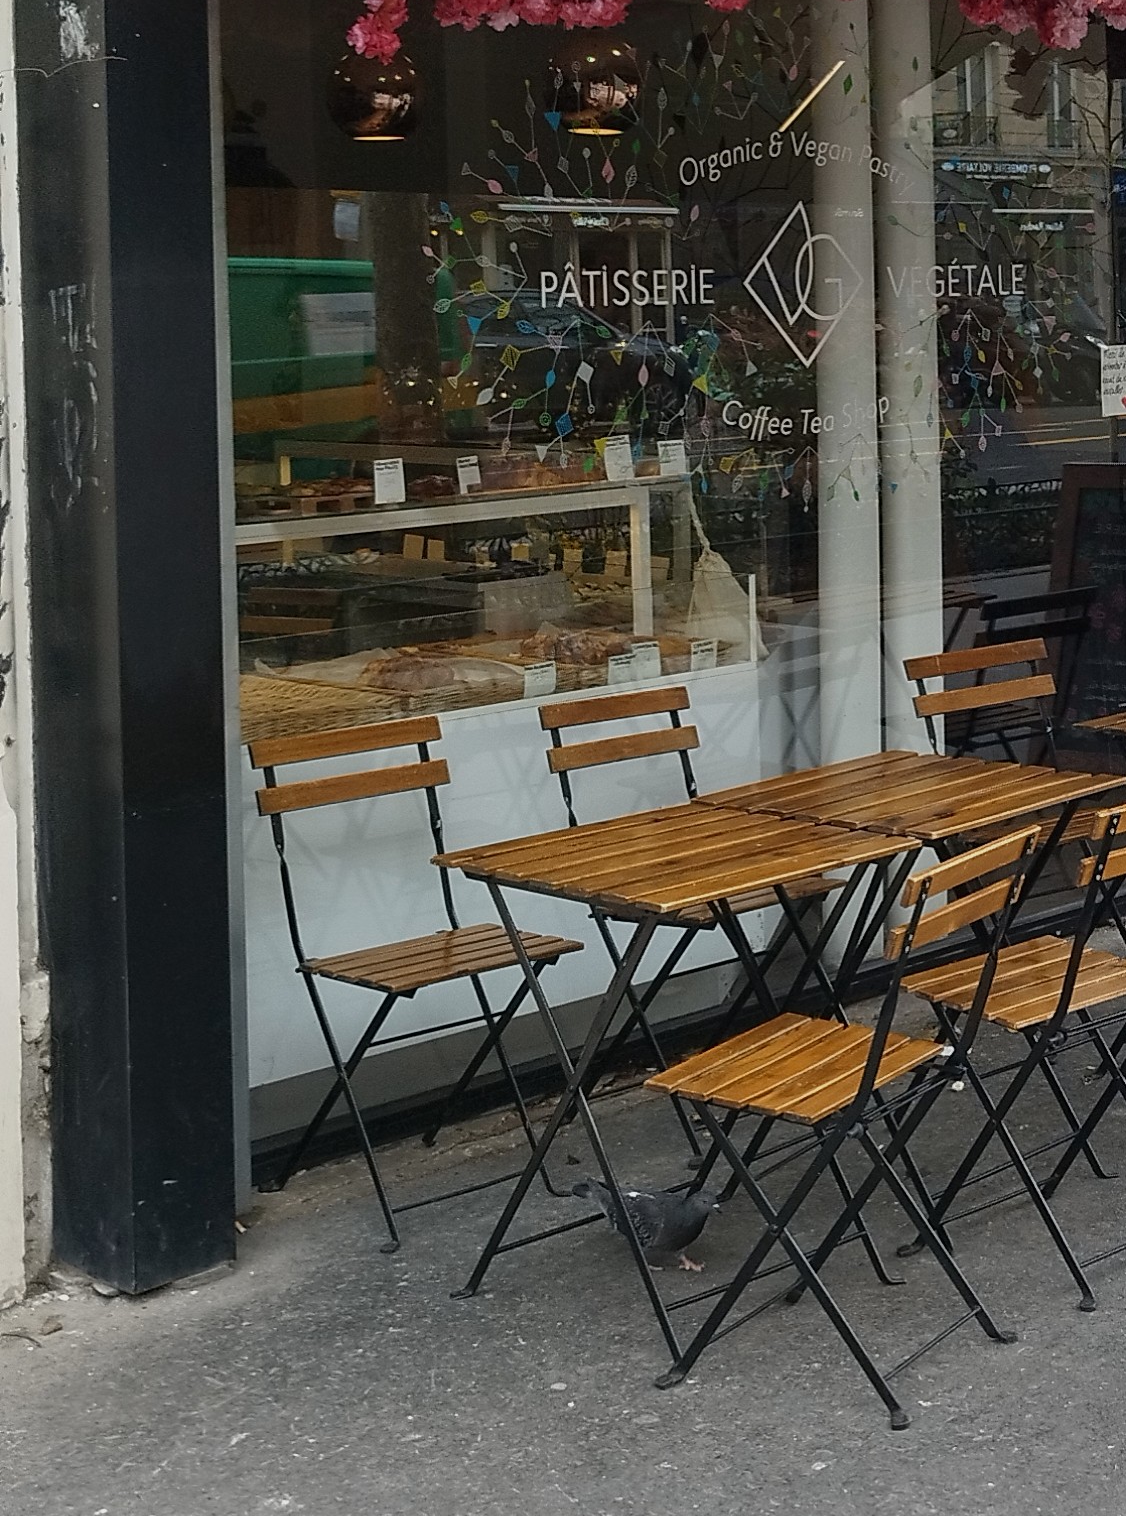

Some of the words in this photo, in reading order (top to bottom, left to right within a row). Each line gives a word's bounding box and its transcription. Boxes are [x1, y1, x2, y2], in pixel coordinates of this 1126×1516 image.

[679, 137, 764, 186] Organic
[768, 131, 784, 158] &
[789, 130, 853, 167] Vegan
[886, 257, 1026, 299] VÉGÉTALE
[721, 399, 794, 442] Coffee
[800, 409, 835, 436] Tea
